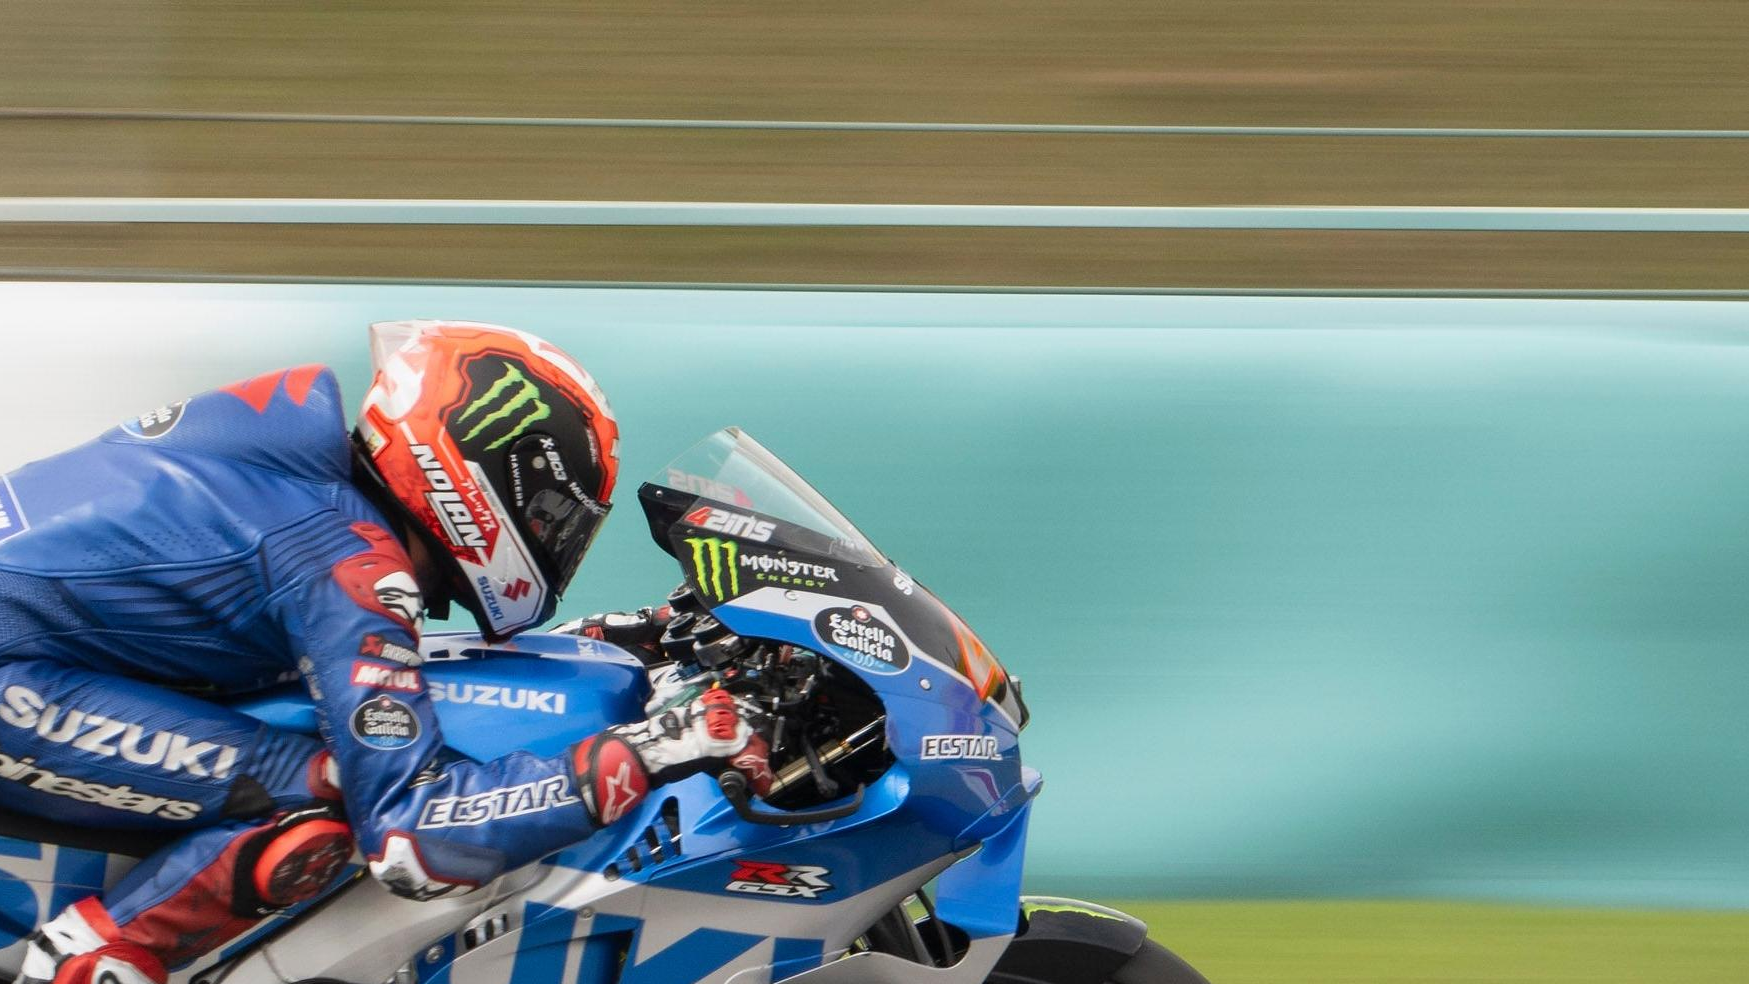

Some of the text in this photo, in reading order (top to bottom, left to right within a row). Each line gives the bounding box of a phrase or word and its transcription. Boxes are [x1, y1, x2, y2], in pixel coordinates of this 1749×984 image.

[409, 443, 489, 549] NOLAN
[509, 453, 524, 507] HAWKERS
[739, 552, 840, 582] MONSTER
[755, 571, 827, 588] ENERGY
[477, 575, 504, 621] SUZUKI
[829, 612, 896, 648] Estrella
[831, 627, 893, 662] Galicia
[427, 681, 566, 716] SUZUKI
[920, 734, 1003, 760] ECSTAR
[415, 774, 582, 830] ECSTAR
